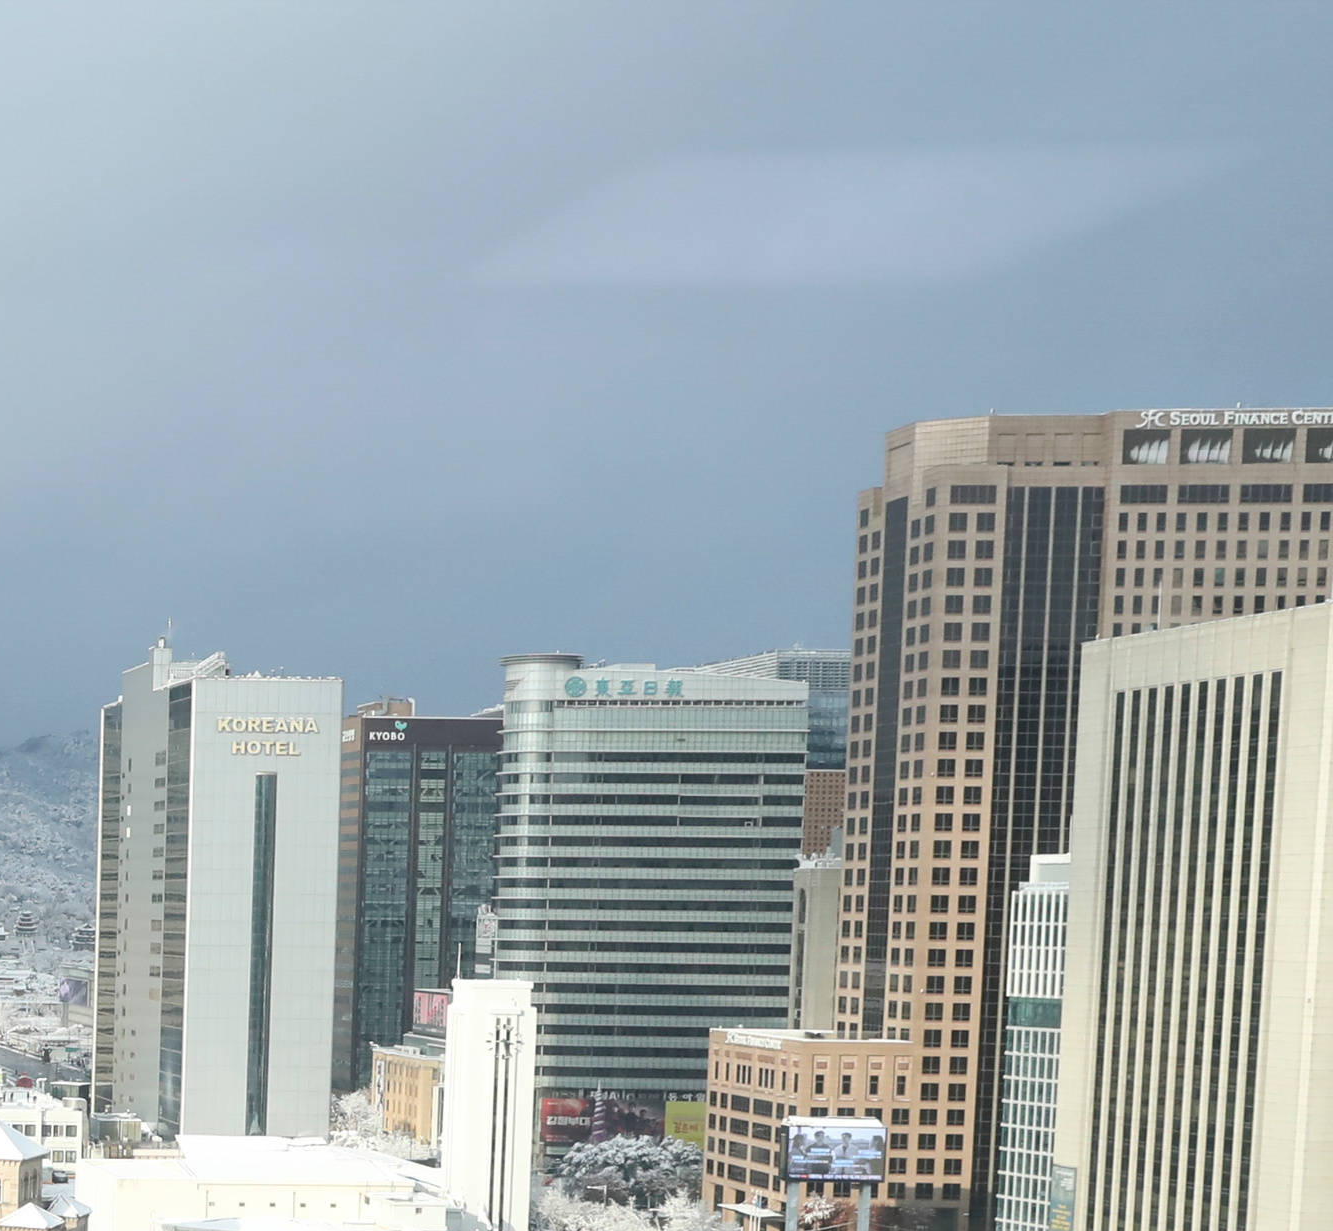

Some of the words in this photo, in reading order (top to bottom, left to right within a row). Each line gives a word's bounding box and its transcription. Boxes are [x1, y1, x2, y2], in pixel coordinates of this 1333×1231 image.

[1170, 411, 1219, 426] SEOUL
[1223, 411, 1289, 425] FINANCE
[217, 716, 319, 733] KOREANA
[369, 731, 405, 741] KYOBO
[231, 740, 301, 756] HOTEL
